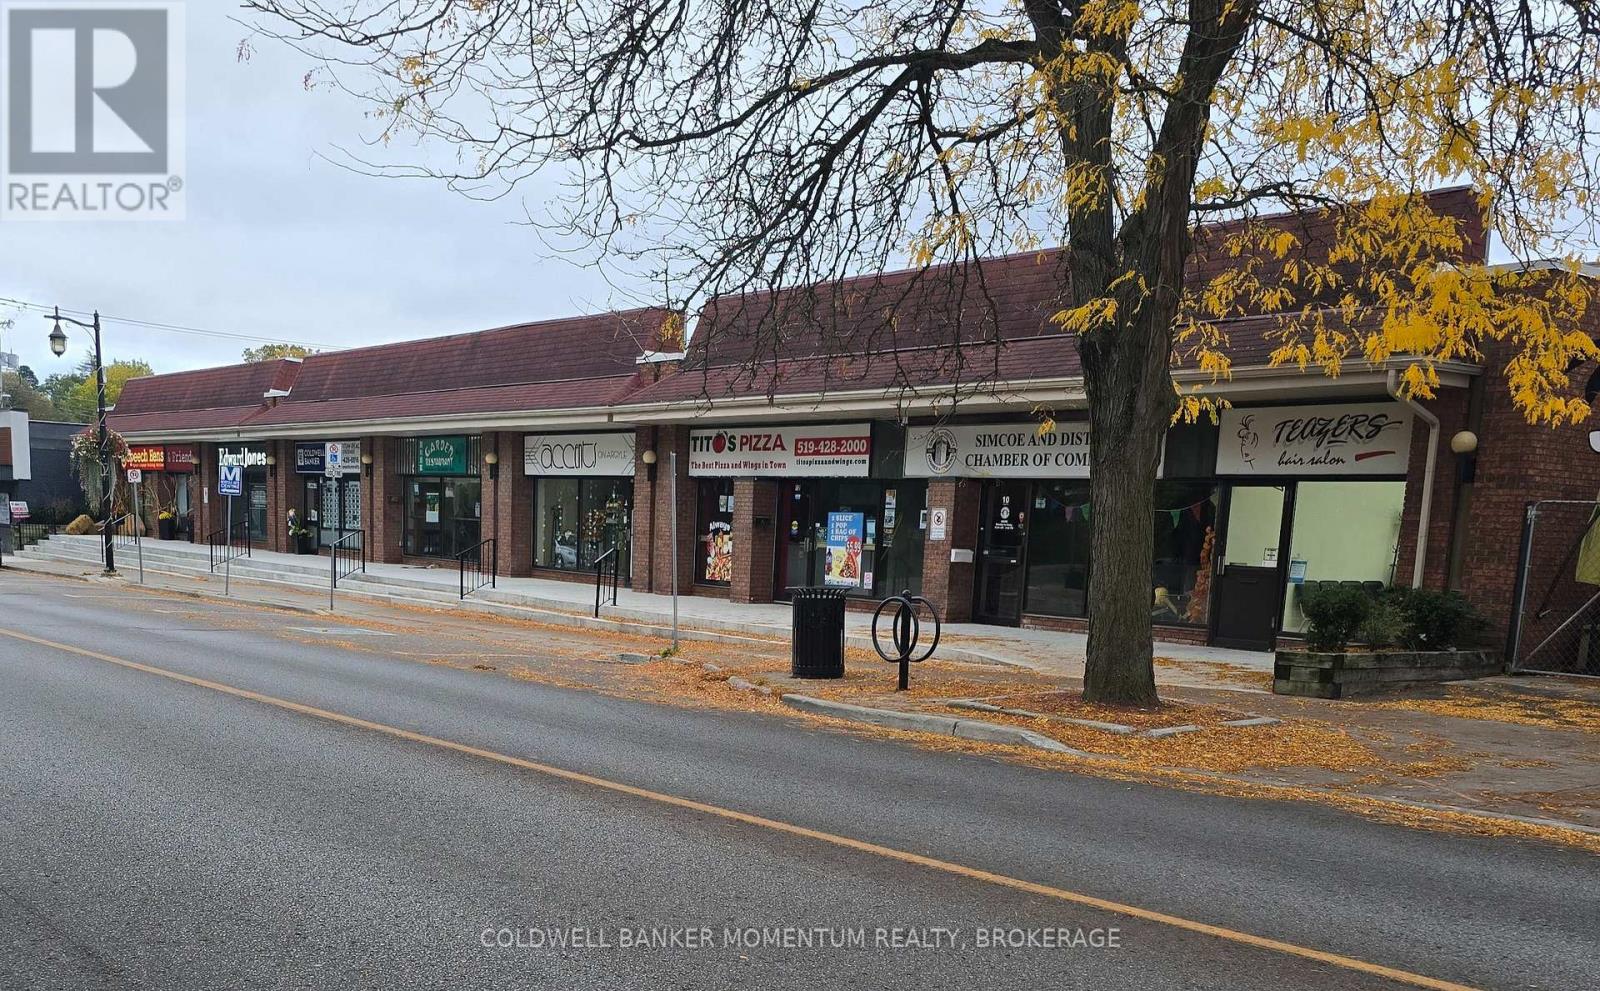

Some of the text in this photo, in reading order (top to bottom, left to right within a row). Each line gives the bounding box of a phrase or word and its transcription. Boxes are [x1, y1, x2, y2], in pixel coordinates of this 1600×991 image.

[1274, 413, 1403, 448] TEAZERS
[424, 439, 454, 457] GARDEN
[691, 431, 788, 453] TITO'S PIZZA
[797, 440, 867, 454] 519-428-2000
[975, 433, 1026, 448] SIMCOE
[1027, 433, 1057, 447] AND
[218, 447, 267, 468] Edward Jones
[796, 458, 867, 467] titospizzaandwings.com
[965, 452, 1090, 467] CHAMBER OF COM
[1278, 449, 1346, 466] hair salon
[220, 466, 240, 481] M
[701, 462, 714, 470] Best
[731, 461, 742, 470] and
[743, 461, 761, 471] Wings
[762, 461, 768, 470] in
[769, 461, 787, 470] Town
[1002, 496, 1010, 504] 10
